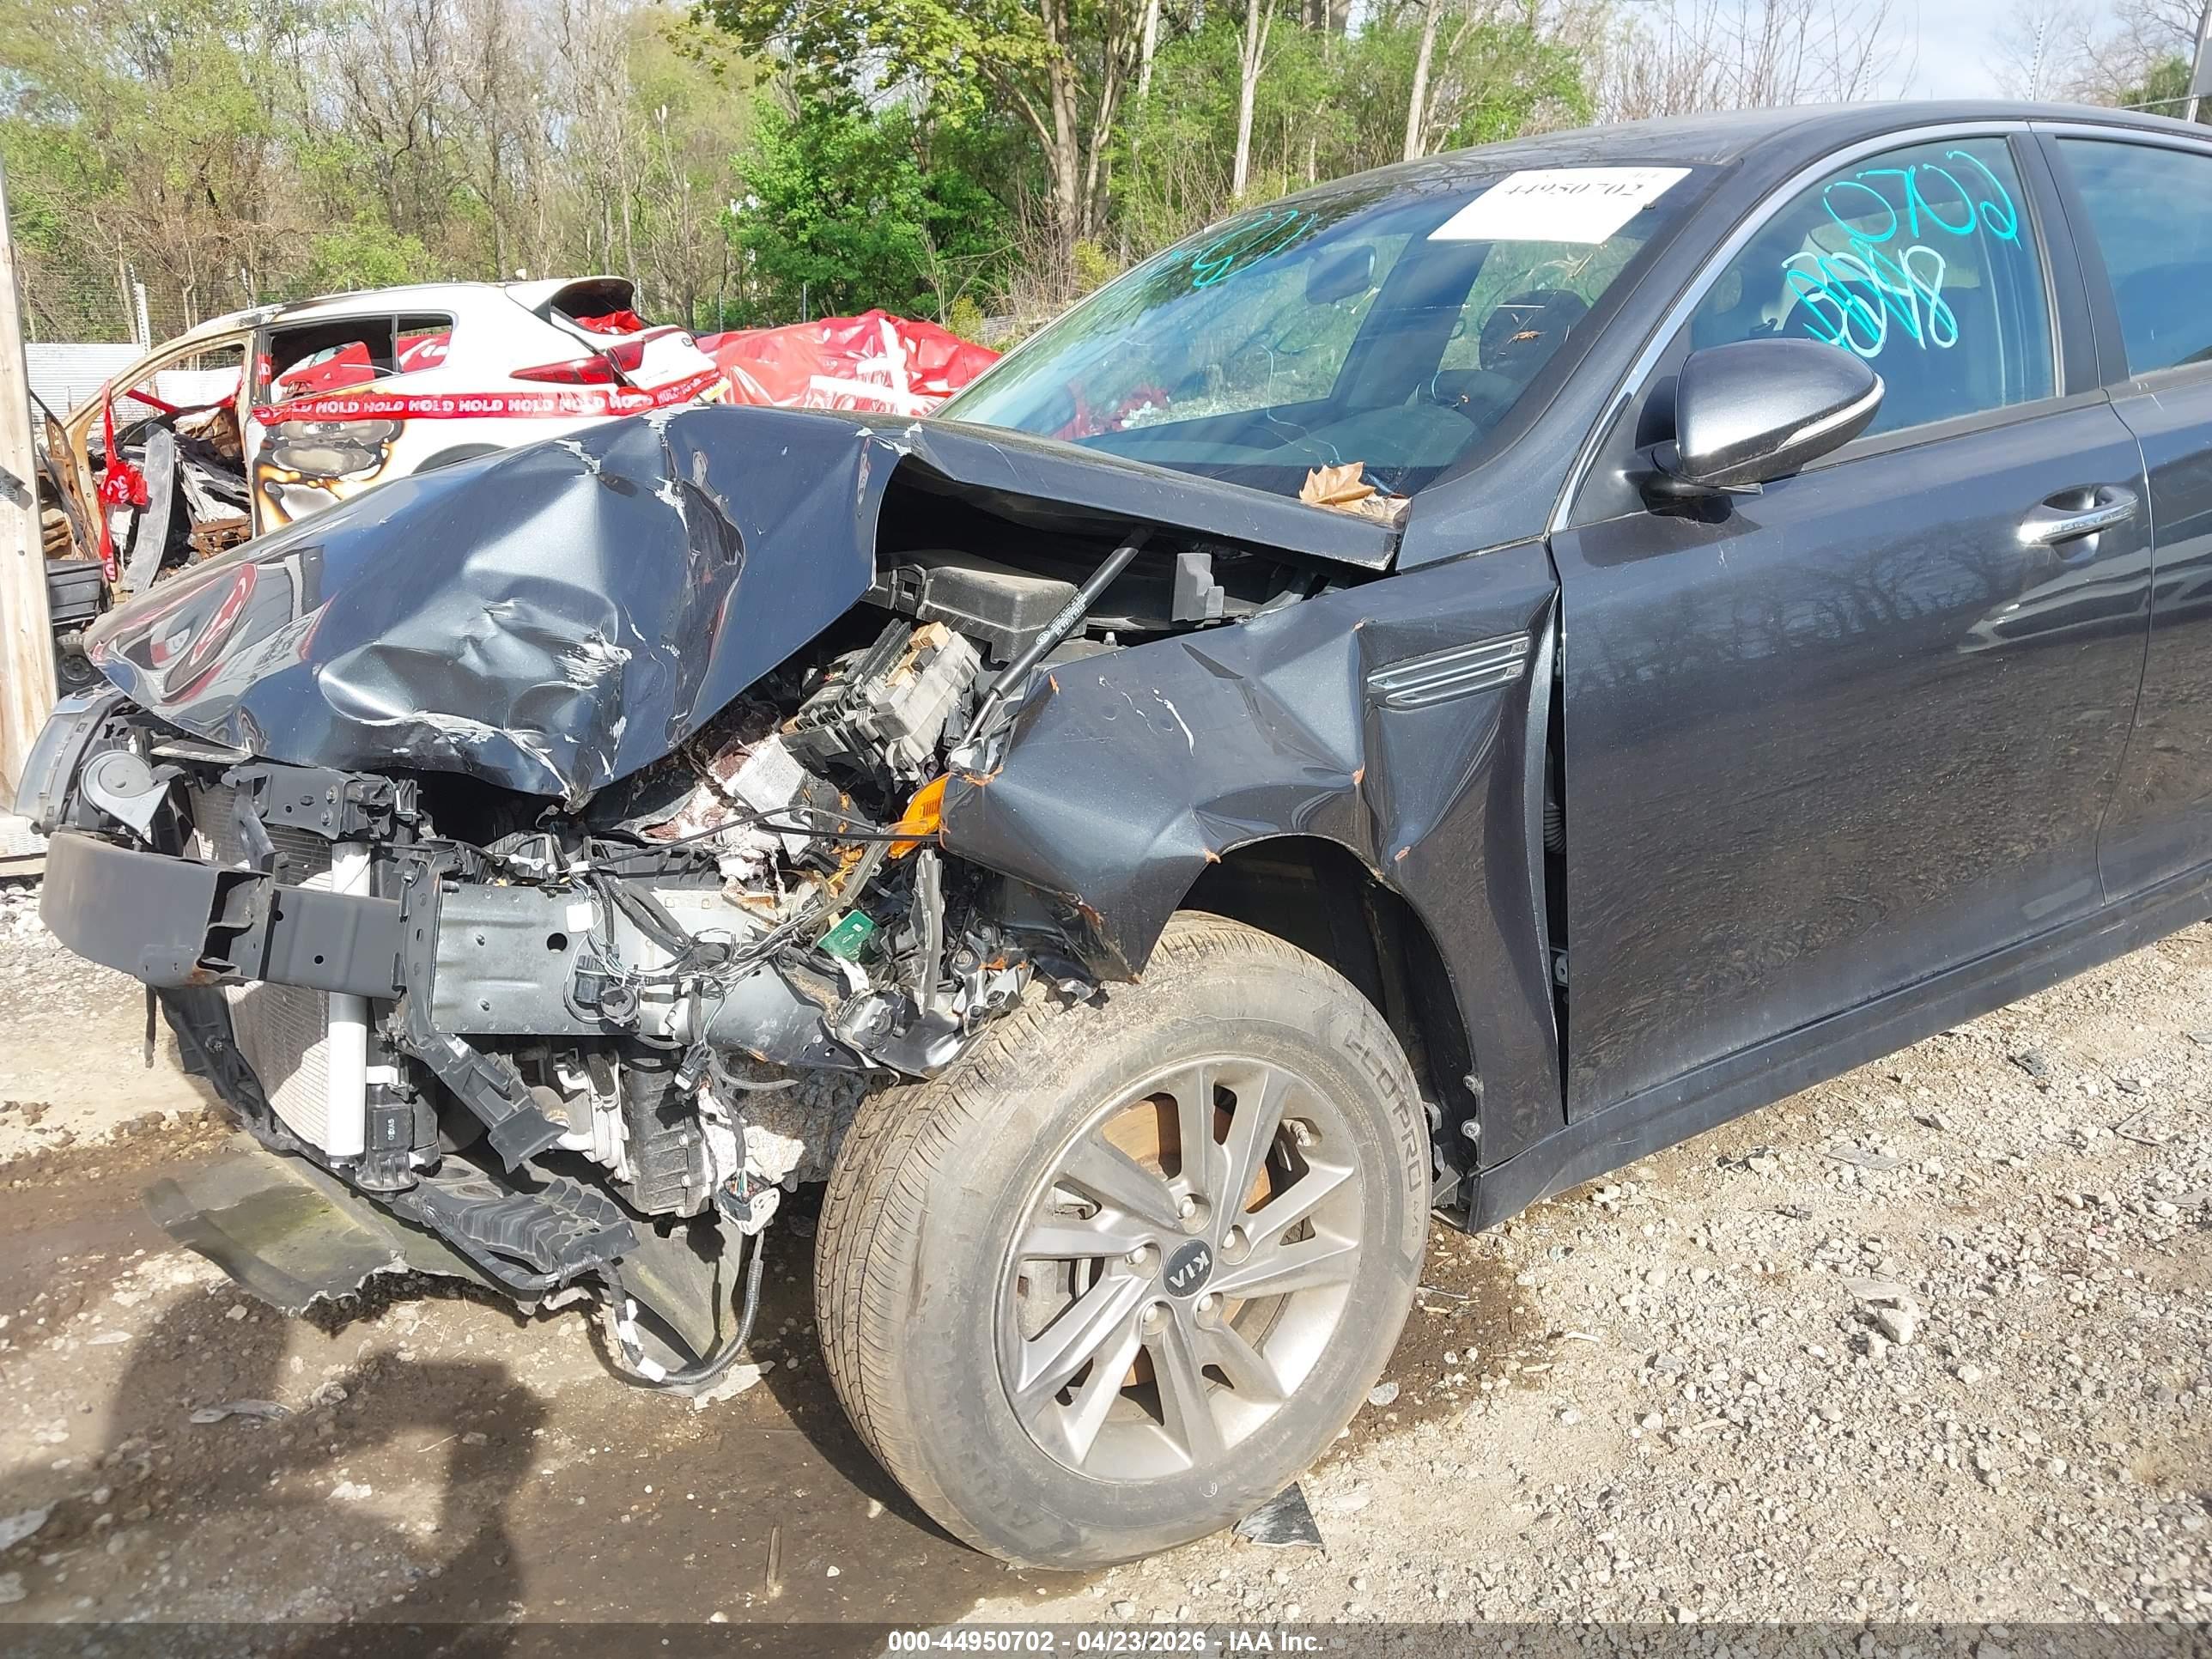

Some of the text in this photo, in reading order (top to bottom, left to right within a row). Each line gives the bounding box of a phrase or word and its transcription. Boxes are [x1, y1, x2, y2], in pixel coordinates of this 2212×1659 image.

[316, 400, 359, 413] HOLD
[364, 401, 406, 412] HOLD
[409, 399, 454, 412] HOLD
[458, 398, 504, 411] HOLD
[508, 398, 554, 412] HOLD
[1169, 1250, 1210, 1289] KIA
